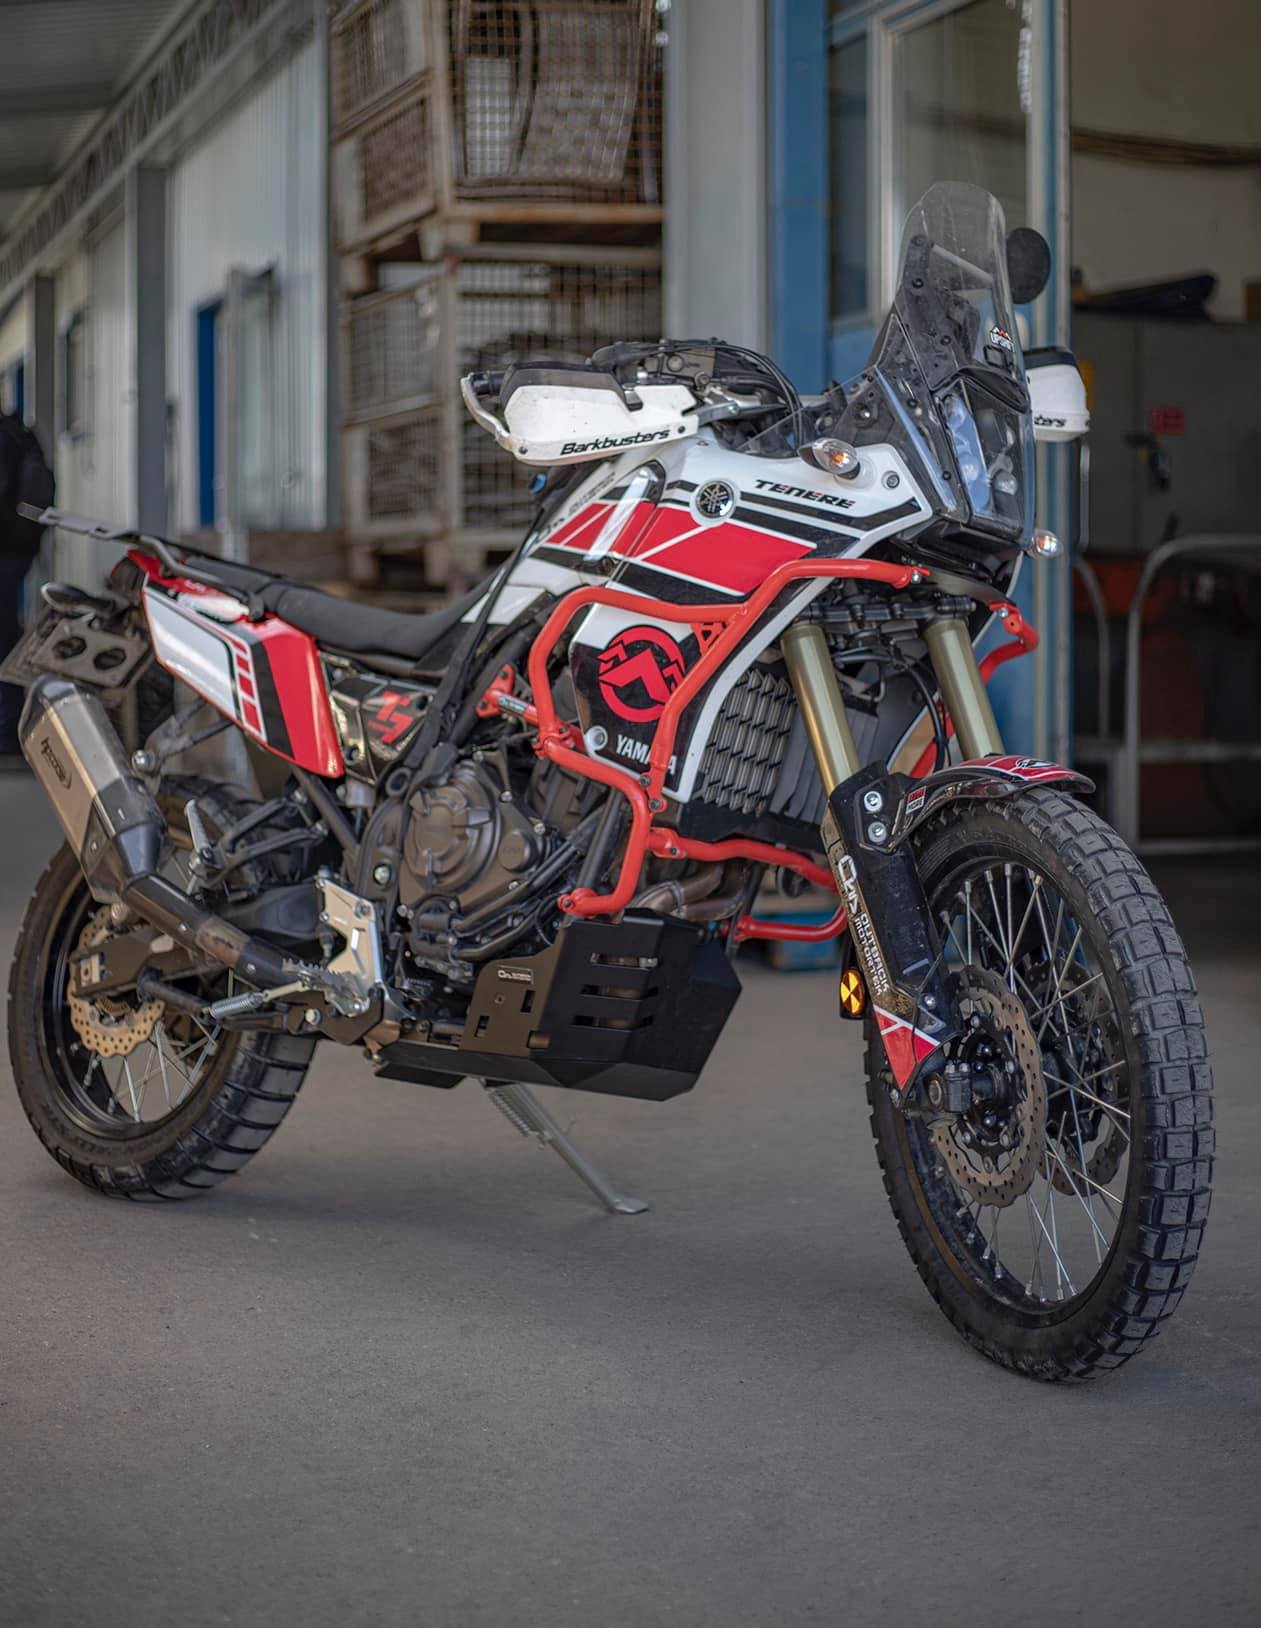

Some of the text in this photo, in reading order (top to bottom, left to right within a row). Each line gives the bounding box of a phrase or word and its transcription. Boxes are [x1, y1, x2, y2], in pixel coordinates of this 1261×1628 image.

[560, 429, 670, 455] Barkbusters
[616, 734, 677, 775] YAMA
[854, 917, 882, 996] MOTORTEK
[860, 913, 890, 992] OUTBACK
